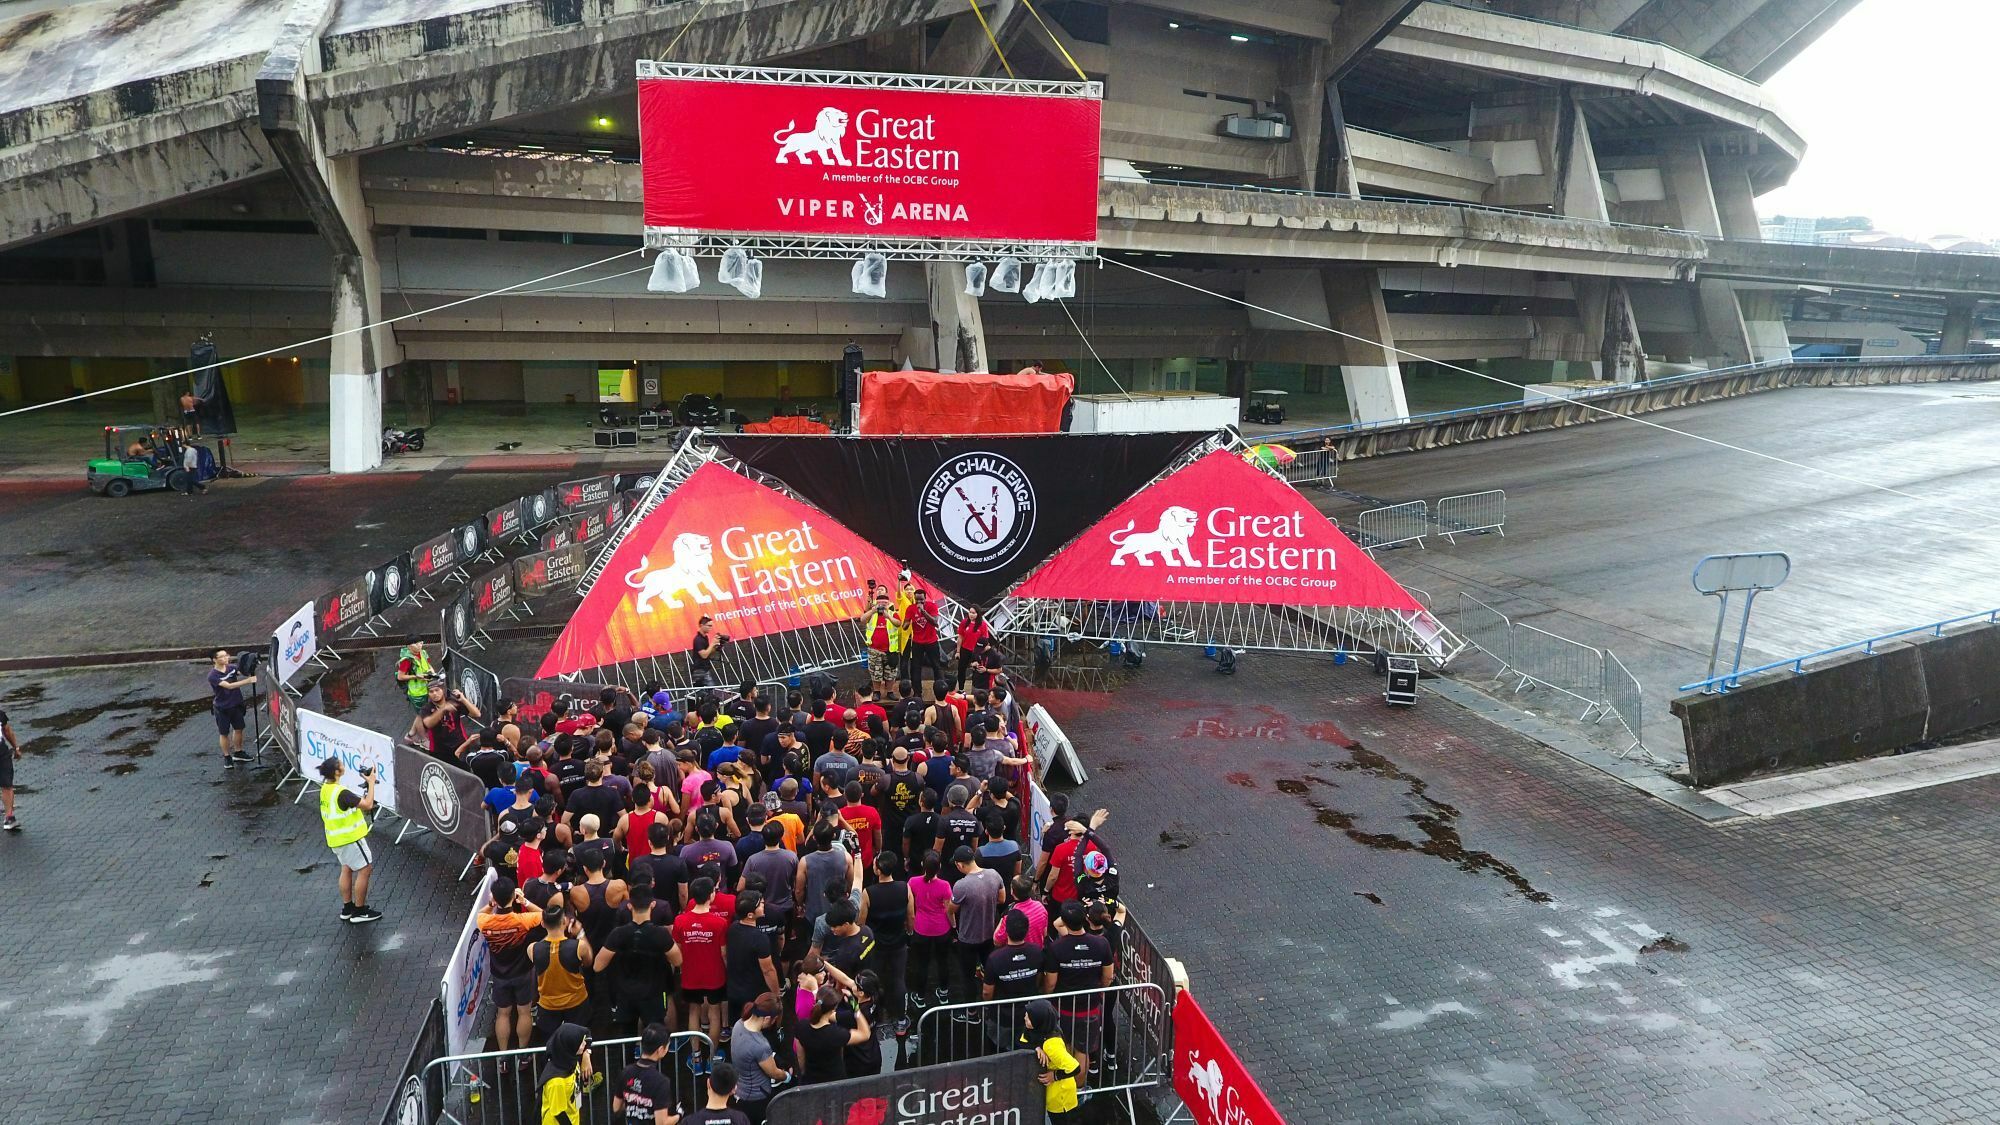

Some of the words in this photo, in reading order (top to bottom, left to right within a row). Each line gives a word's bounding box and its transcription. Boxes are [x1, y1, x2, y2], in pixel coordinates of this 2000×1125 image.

[855, 108, 936, 141] Great
[855, 139, 960, 171] Eastern
[822, 172, 830, 181] A
[832, 173, 871, 183] member
[873, 174, 883, 183] of
[884, 174, 901, 184] the
[902, 175, 929, 185] OCBC
[931, 176, 960, 188] Group
[777, 197, 855, 219] VIPER
[890, 202, 969, 222] ARENA
[581, 481, 602, 494] Great
[582, 490, 609, 502] Eastern
[924, 470, 956, 516] VIPER
[955, 457, 1031, 512] CHALLENGE
[502, 508, 515, 521] Great
[1206, 506, 1304, 539] Great
[431, 541, 449, 557] Great
[720, 520, 819, 562] Great
[432, 551, 454, 569] Eastern
[546, 553, 572, 569] Great
[1206, 538, 1337, 572] Eastern
[491, 573, 506, 592] Great
[547, 563, 581, 581] Eastern
[729, 554, 858, 597] Eastern
[1166, 575, 1175, 584] A
[1177, 575, 1225, 585] member
[1228, 575, 1241, 585] of
[1243, 575, 1262, 585] the
[1265, 576, 1298, 587] OCBC
[1301, 577, 1338, 590] Group
[340, 588, 358, 608] Great
[492, 585, 511, 605] Eastern
[714, 605, 762, 622] member
[764, 602, 776, 613] of
[778, 599, 797, 611] the
[798, 592, 829, 607] OCBC
[830, 586, 863, 602] Group
[340, 599, 365, 622] Eastern
[1120, 929, 1153, 985] Great
[897, 1077, 993, 1118] Great
